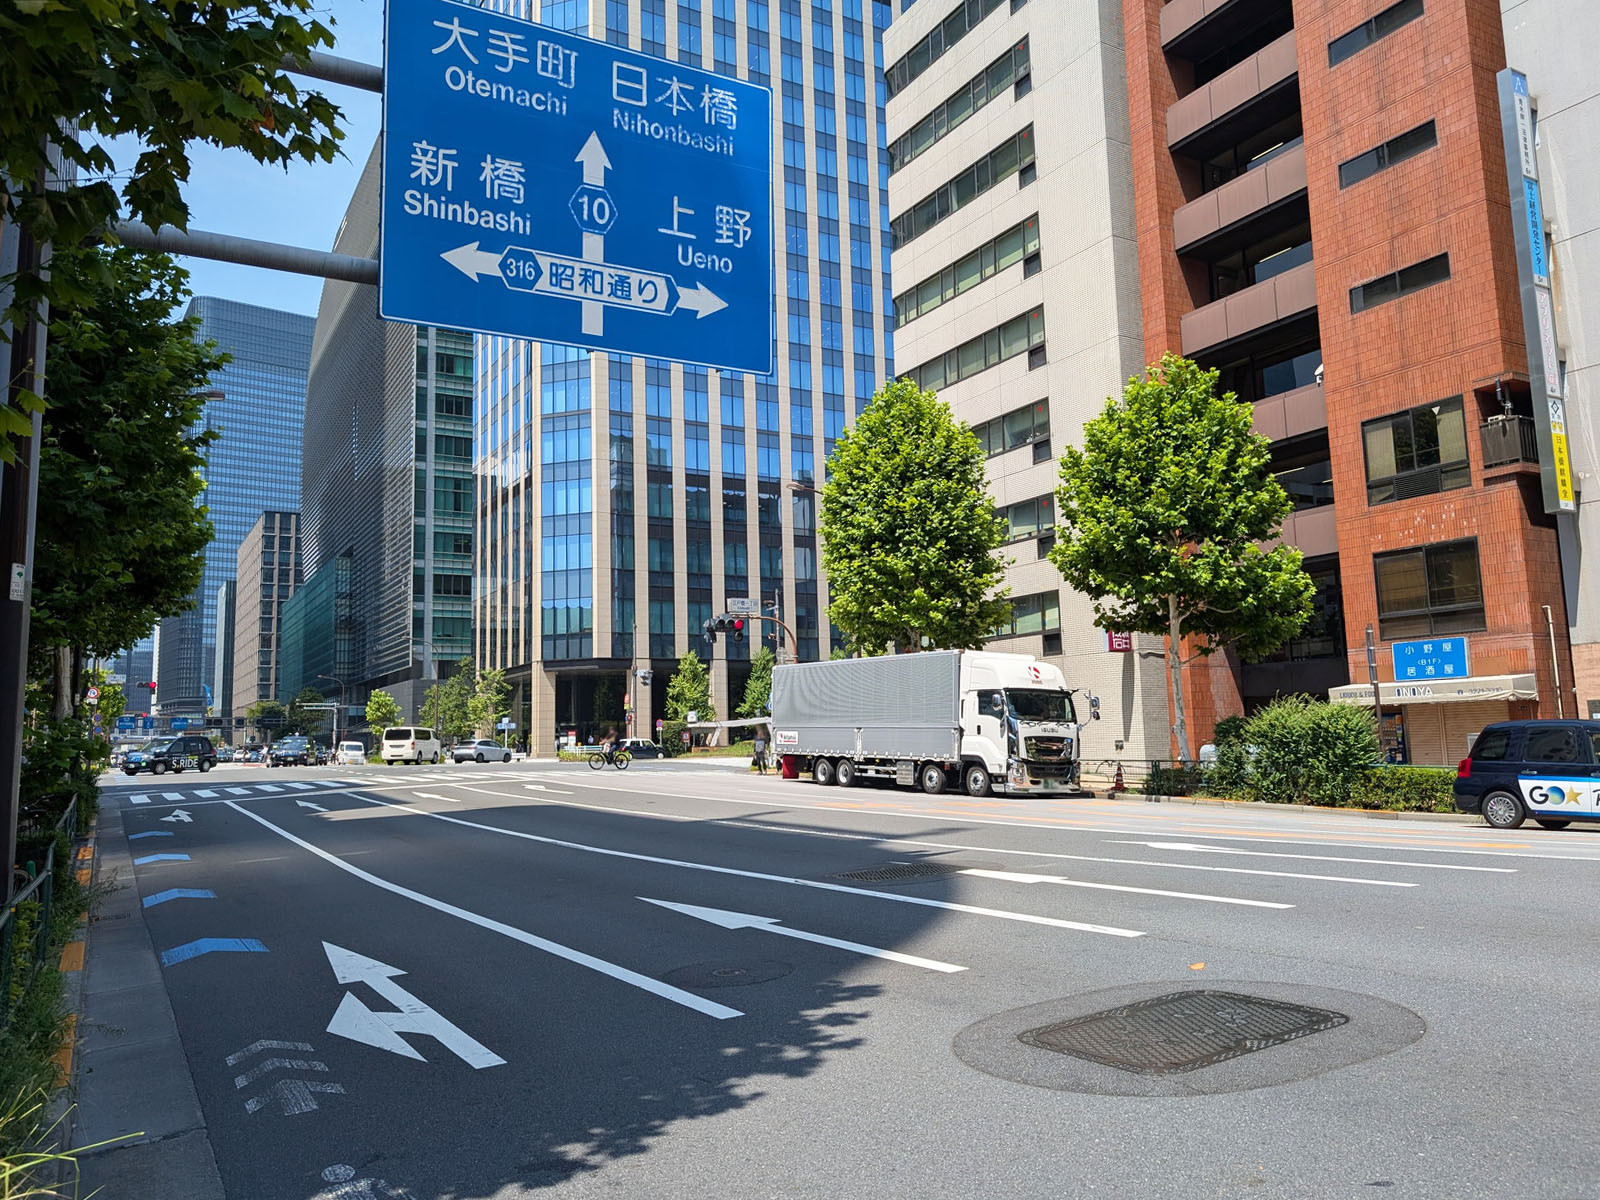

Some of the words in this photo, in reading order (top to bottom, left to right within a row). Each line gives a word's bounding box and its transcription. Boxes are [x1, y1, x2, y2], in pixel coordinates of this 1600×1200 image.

[431, 17, 578, 89] 大手町
[445, 65, 568, 116] Otemachi
[612, 60, 737, 131] 日本橋
[612, 108, 735, 157] Nihonbashi
[410, 139, 526, 205] 新橋
[403, 189, 531, 237] Shinbashi
[577, 194, 610, 225] 10
[658, 195, 752, 249] 上野
[505, 258, 536, 281] 316
[677, 244, 733, 274] Ueno
[548, 261, 659, 305] 昭和通り
[1404, 642, 1453, 655] 小野屋
[1407, 663, 1454, 677] 居酒屋
[1364, 690, 1377, 698] FOO
[1395, 685, 1433, 698] ONOYA
[171, 758, 199, 769] S.RIDE
